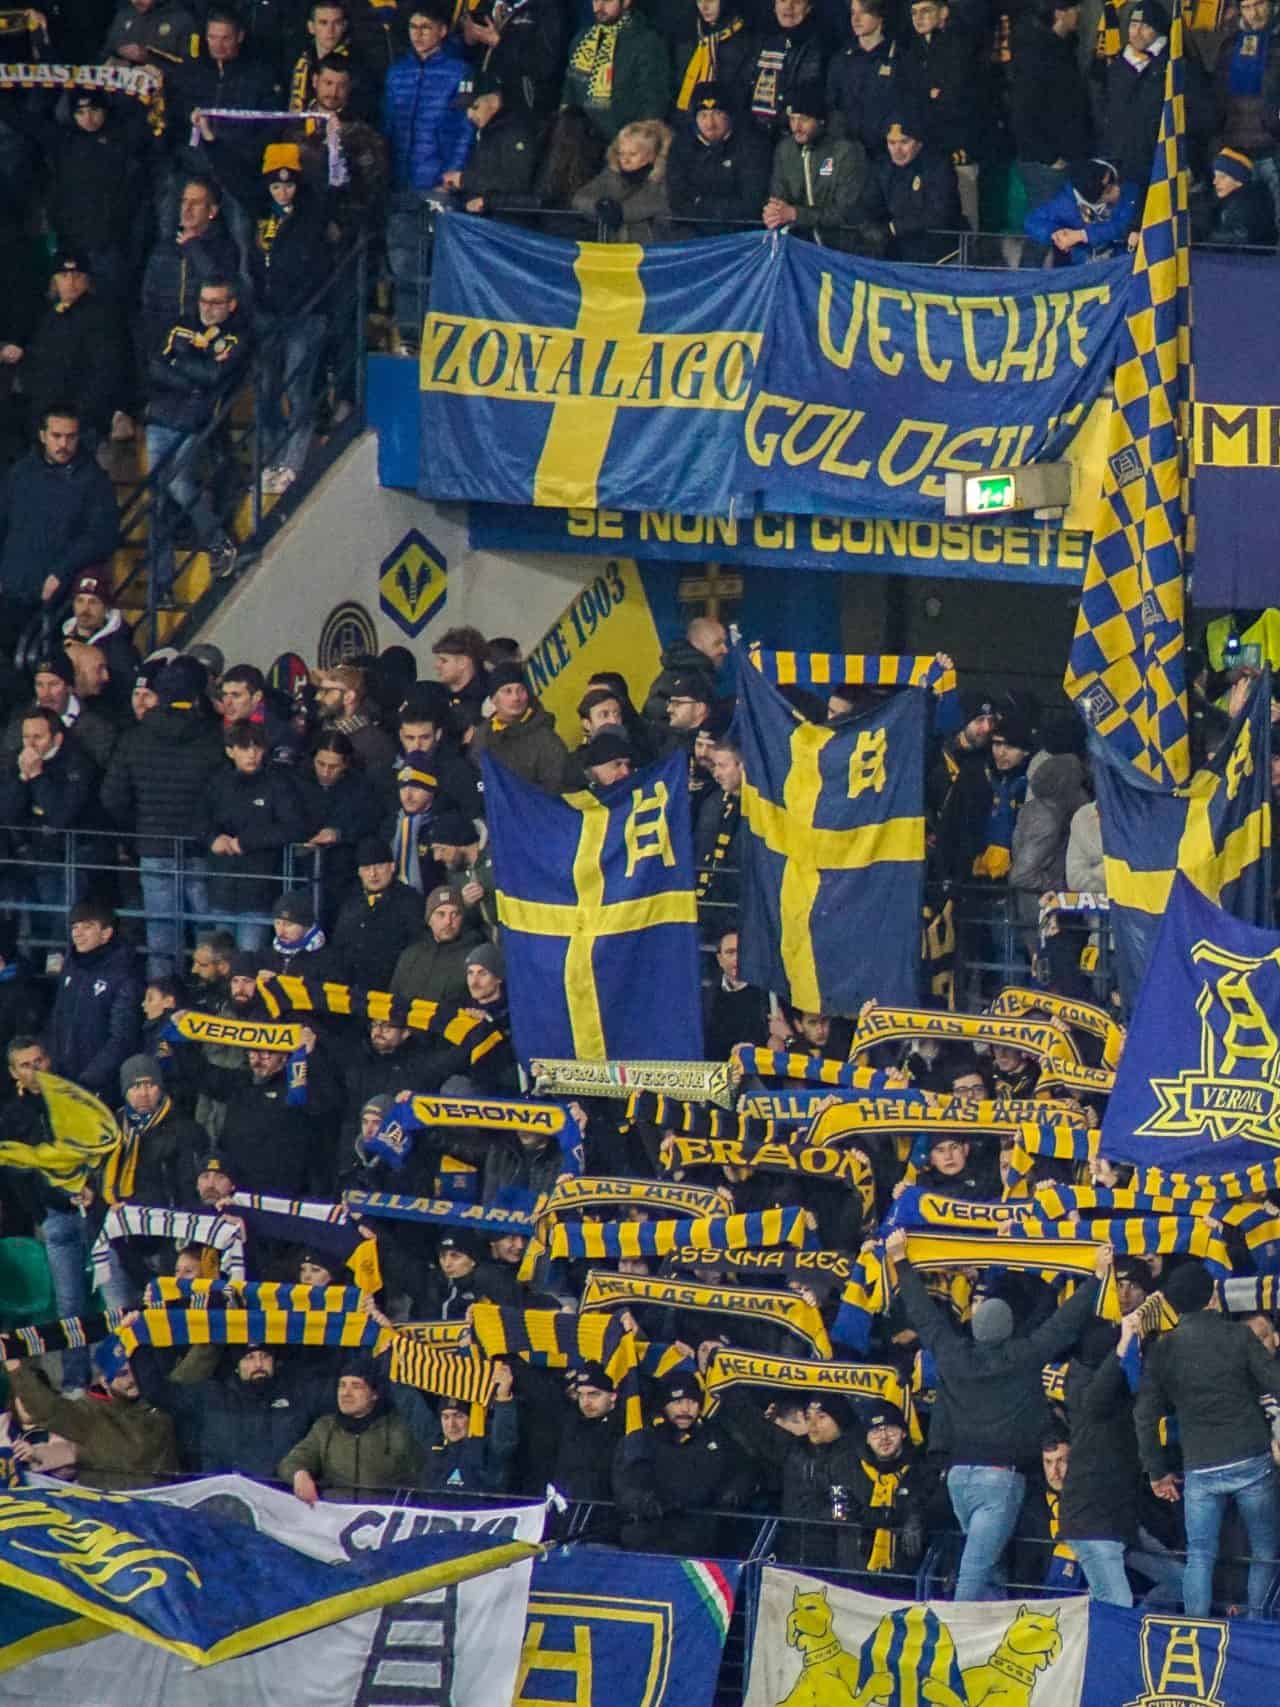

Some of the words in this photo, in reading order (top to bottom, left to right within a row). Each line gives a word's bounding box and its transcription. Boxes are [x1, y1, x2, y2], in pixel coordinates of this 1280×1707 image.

[0, 64, 70, 83] LLAS
[817, 271, 1111, 383] VECCHIE
[428, 320, 753, 401] ZONALAGO
[744, 391, 1083, 497] GOLOSI
[568, 509, 624, 540] SE
[639, 510, 735, 548] NON
[754, 515, 795, 550] CI
[811, 519, 1087, 568] CONOSCETE
[522, 641, 572, 697] INCE
[570, 568, 624, 647] 1903
[187, 1019, 294, 1046] VERONA
[855, 1015, 963, 1040] HELLAS
[978, 1024, 1061, 1049] ARMY
[550, 1065, 609, 1082] FORZA
[630, 1069, 704, 1088] VERONA
[425, 1101, 552, 1128] VERONA
[740, 1096, 819, 1120] HELLA
[860, 1104, 978, 1122] HELLAS
[994, 1109, 1086, 1128] ARMY
[345, 1189, 453, 1215] ELLAS
[460, 1204, 535, 1225] ARM
[928, 1200, 1037, 1222] VERON
[672, 1247, 783, 1267] SSUNA
[795, 1251, 850, 1278] RES
[598, 1279, 697, 1305] HELLAS
[708, 1295, 795, 1314] ARMY
[402, 1327, 470, 1345] HELLA
[718, 1358, 807, 1381] HELLAS
[818, 1370, 887, 1390] ARMY
